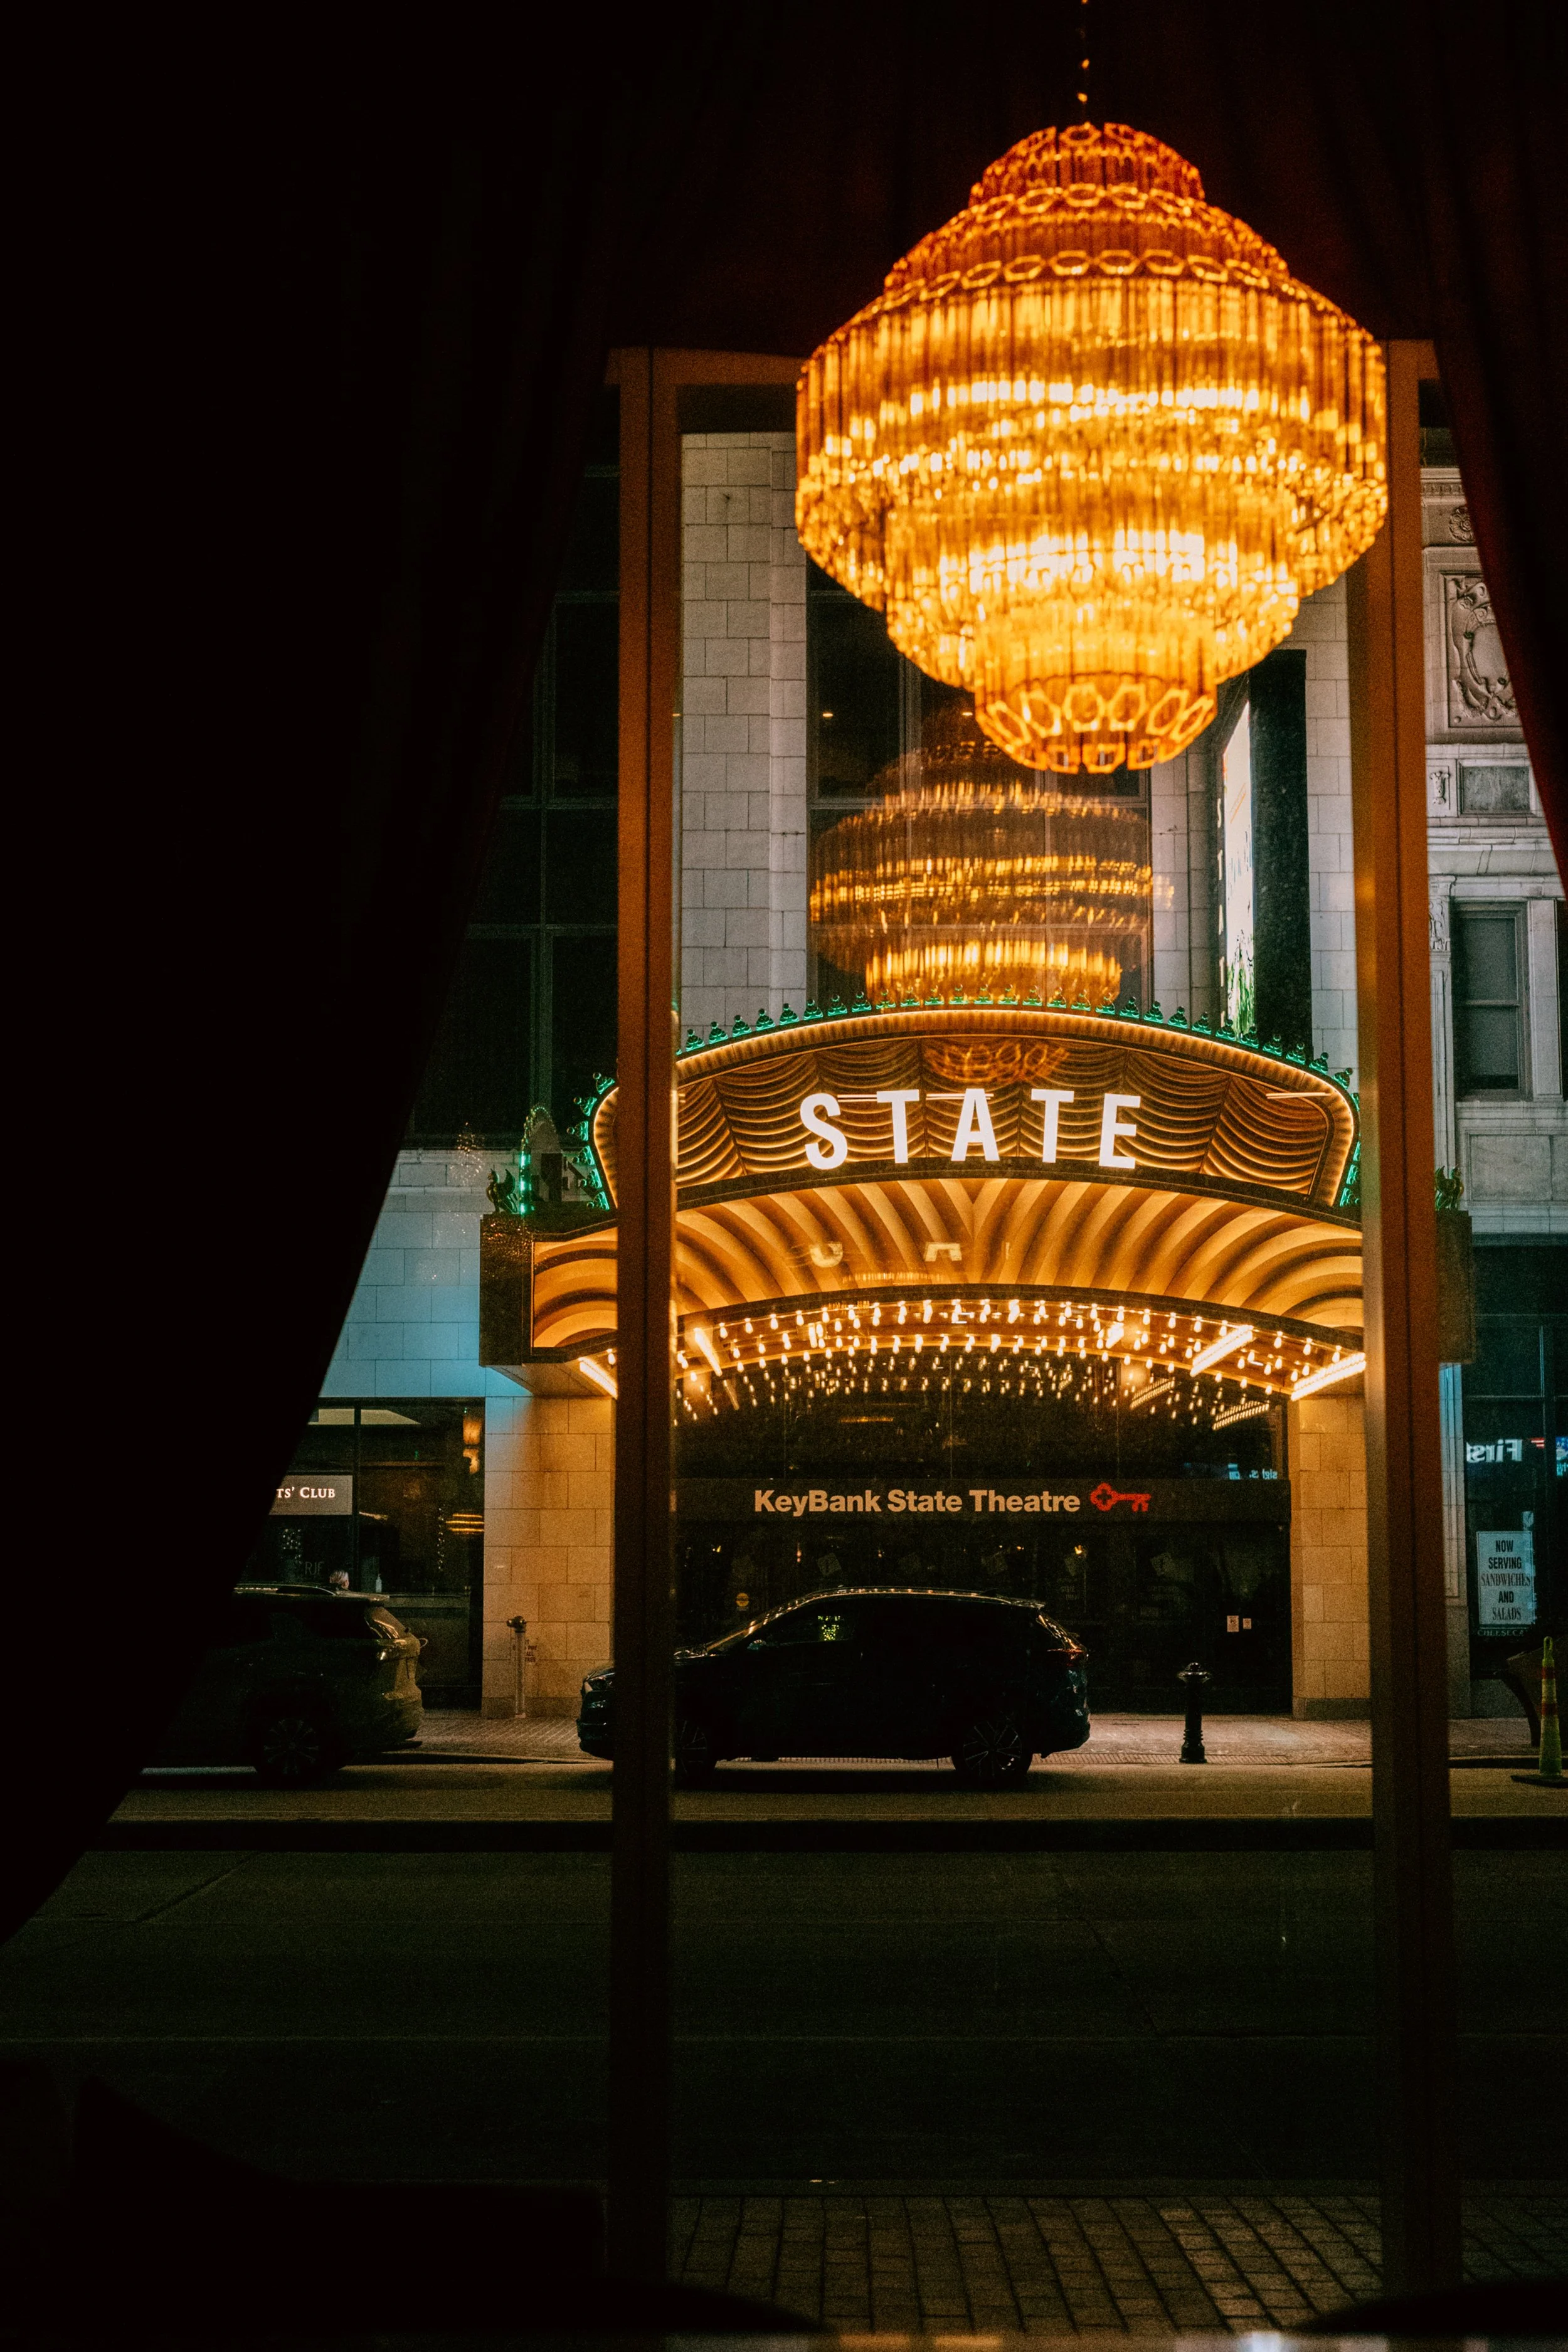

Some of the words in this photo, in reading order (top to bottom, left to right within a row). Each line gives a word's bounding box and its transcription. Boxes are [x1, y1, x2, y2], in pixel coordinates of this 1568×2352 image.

[800, 1088, 1142, 1169] STATE
[755, 1490, 881, 1517] KeyBank
[887, 1490, 963, 1512] State
[969, 1490, 1081, 1512] Theatre
[1496, 1540, 1513, 1552] NOW
[1488, 1557, 1522, 1569] SERVING
[1481, 1573, 1531, 1587] SANDWICHES
[1498, 1591, 1514, 1603] AND
[1492, 1607, 1522, 1620] SALADS
